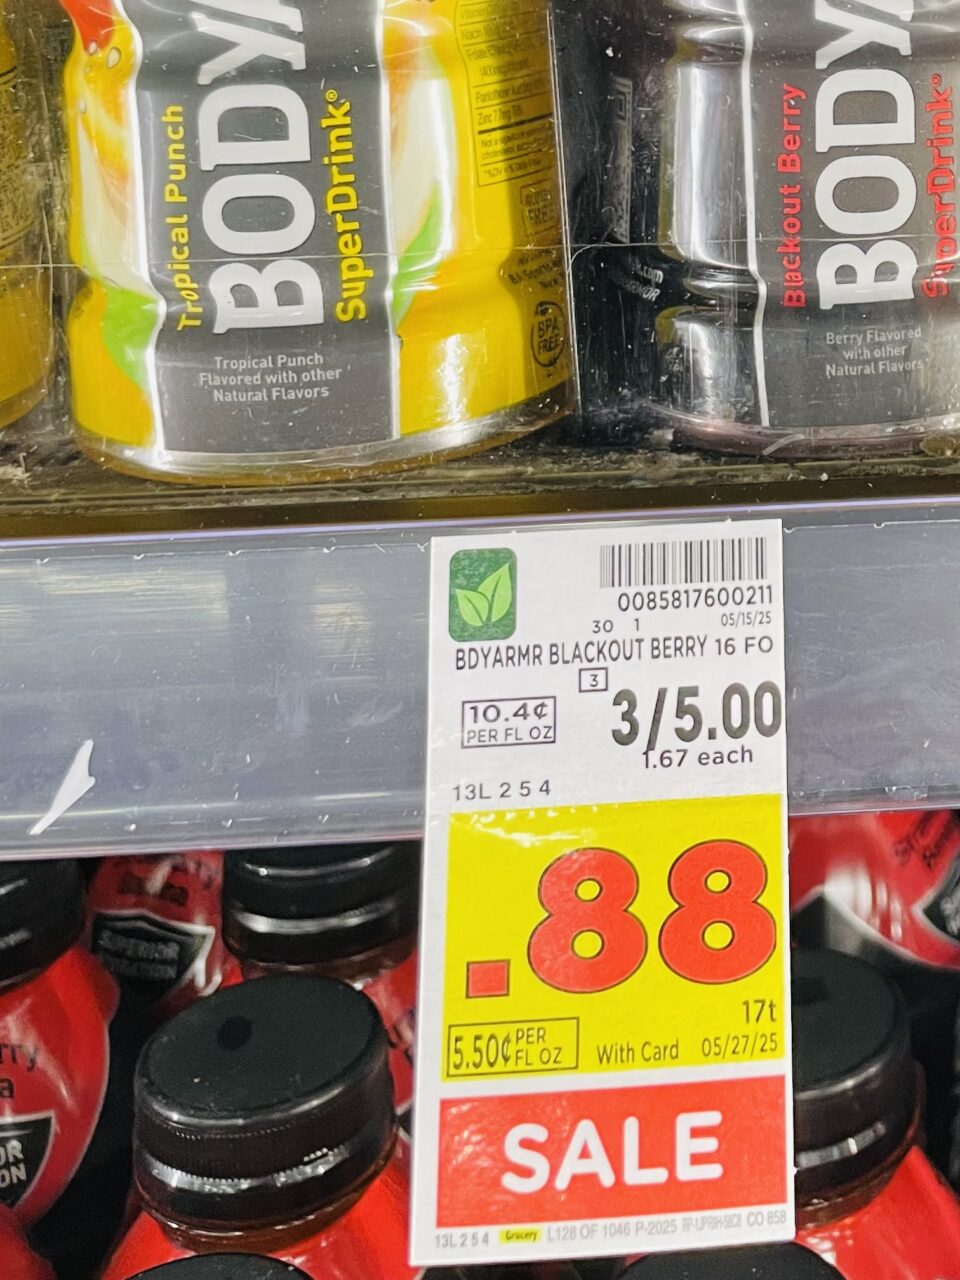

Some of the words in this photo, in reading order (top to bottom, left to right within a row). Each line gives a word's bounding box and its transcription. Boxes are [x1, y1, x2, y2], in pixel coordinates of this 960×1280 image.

[777, 82, 808, 174] Berry
[161, 103, 187, 204] Punch
[772, 184, 807, 308] Blackout
[165, 213, 203, 331] Tropical
[826, 331, 863, 347] Berry
[866, 325, 922, 342] Flavored
[215, 355, 273, 371] Tropical
[277, 352, 323, 367] Punch
[843, 346, 871, 360] with
[874, 343, 908, 359] other
[200, 371, 261, 387] Flavored
[264, 369, 297, 385] with
[301, 366, 342, 382] other
[826, 362, 875, 378] Natural
[878, 358, 923, 374] Flavors
[214, 387, 268, 403] Natural
[273, 384, 329, 401] Flavors
[618, 585, 773, 612] 0085817600211
[592, 620, 613, 634] 30
[720, 611, 772, 628] 05/15/25
[455, 644, 543, 670] BDYARMR
[550, 638, 644, 666] BLACKOUT
[651, 635, 707, 660] BERRY
[715, 638, 735, 657] 16
[745, 635, 774, 654] FO
[589, 674, 599, 687] 3
[469, 701, 549, 725] 10.4¢
[611, 680, 782, 751] 3/5.00
[467, 729, 498, 744] PER
[505, 727, 524, 742] FL
[529, 726, 553, 741] OZ
[642, 749, 688, 769] 1.67
[698, 745, 753, 766] each
[453, 784, 492, 801] 13L
[500, 782, 511, 798] 2
[519, 781, 531, 797] 5
[539, 779, 551, 795] 4
[465, 838, 777, 999] .88
[742, 999, 777, 1024] 17t
[452, 1029, 513, 1071] 5.50¢
[515, 1027, 546, 1045] PER
[515, 1049, 533, 1067] FL
[539, 1047, 562, 1065] OZ
[597, 1041, 636, 1066] With
[641, 1039, 679, 1062] Card
[702, 1032, 778, 1058] 05/27/25
[501, 1110, 723, 1195] SALE
[505, 1228, 538, 1243] Grocery
[547, 1226, 576, 1243] L128
[580, 1224, 599, 1240] OF
[602, 1222, 631, 1239] 1046
[634, 1218, 677, 1236] P-2025
[747, 1213, 764, 1226] CO
[766, 1210, 786, 1225] 858
